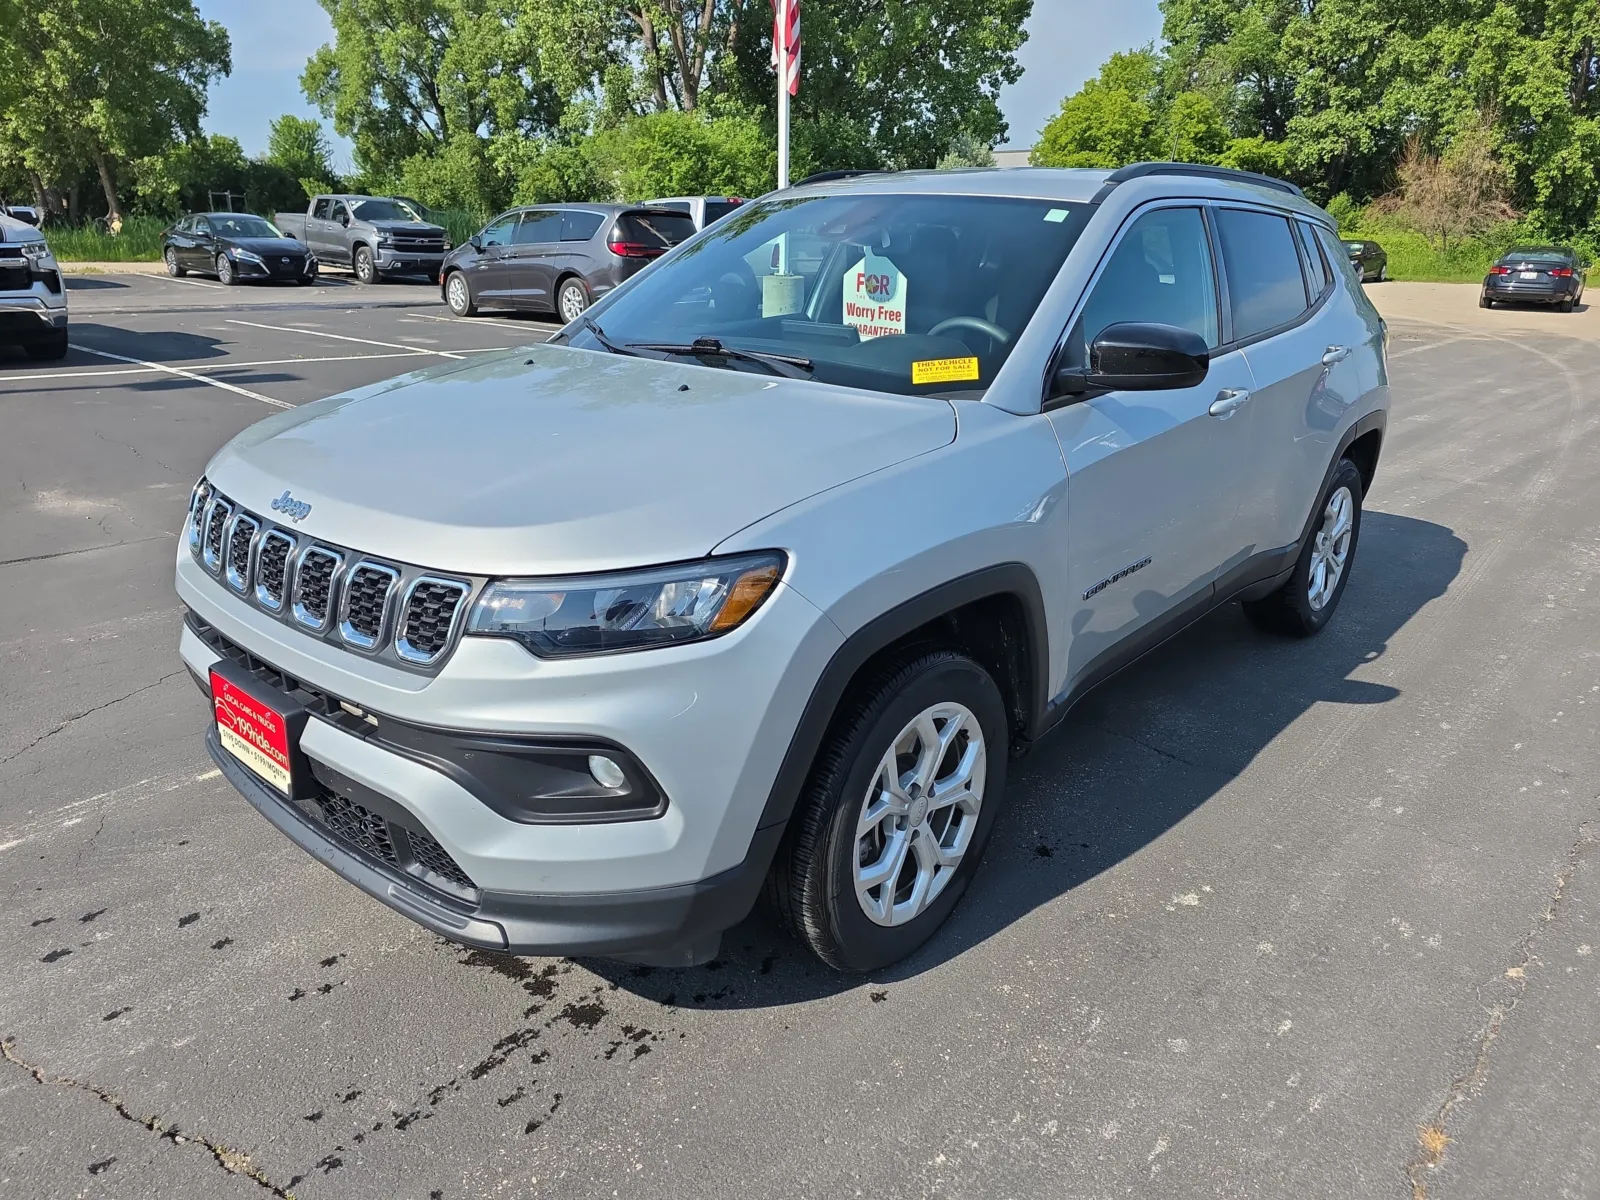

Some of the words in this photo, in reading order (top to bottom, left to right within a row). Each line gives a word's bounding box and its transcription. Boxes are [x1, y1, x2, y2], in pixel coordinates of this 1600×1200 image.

[856, 272, 890, 296] FOR
[846, 302, 875, 322] Worry
[878, 305, 902, 322] Free
[938, 358, 974, 366] VEHICLE
[271, 490, 312, 524] Jeep
[1082, 555, 1153, 601] COMPASS
[224, 692, 240, 710] LOCAL
[240, 701, 253, 718] CARS
[257, 714, 276, 733] TRUCKS
[234, 737, 251, 756] DOWN
